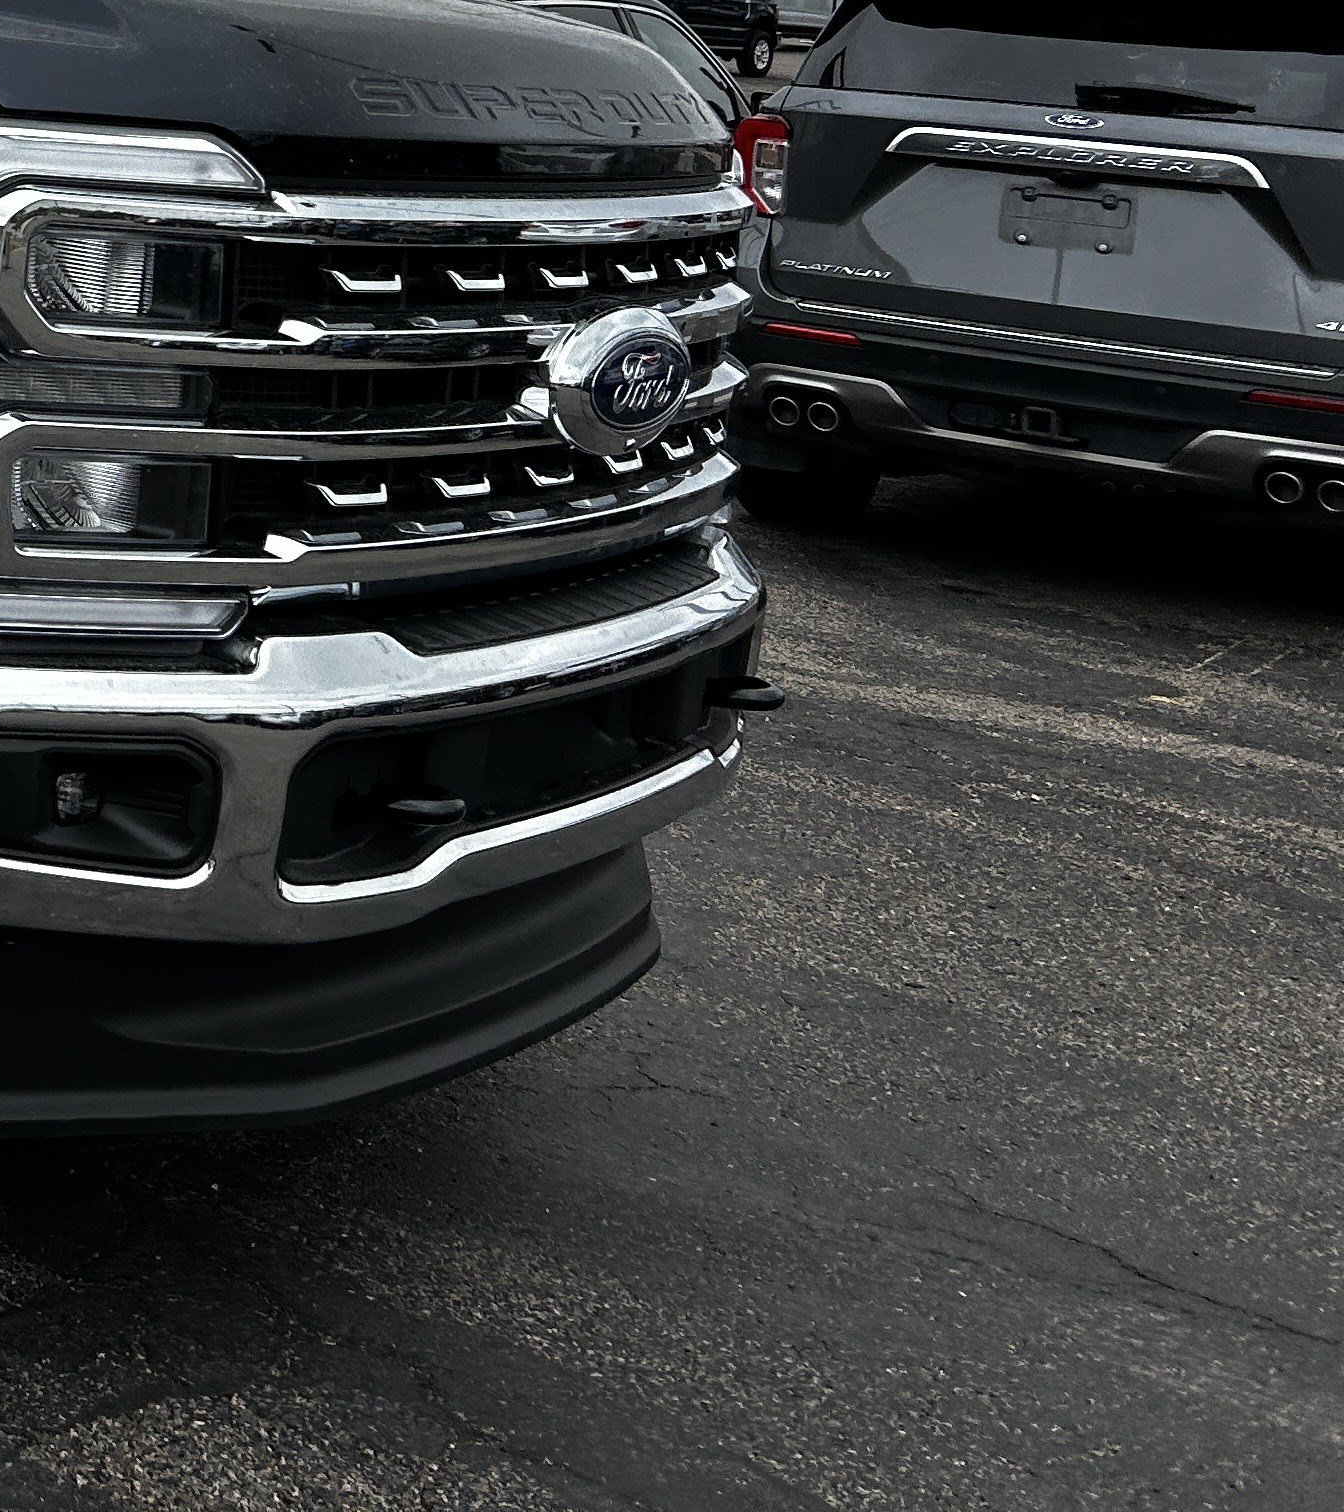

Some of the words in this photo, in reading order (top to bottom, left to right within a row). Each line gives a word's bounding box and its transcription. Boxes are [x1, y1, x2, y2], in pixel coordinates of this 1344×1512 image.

[348, 75, 606, 128] SUPER
[1056, 114, 1090, 125] Ford
[944, 140, 1195, 174] EXPLORER
[779, 259, 892, 279] PLATINUM
[613, 352, 673, 415] Ford
